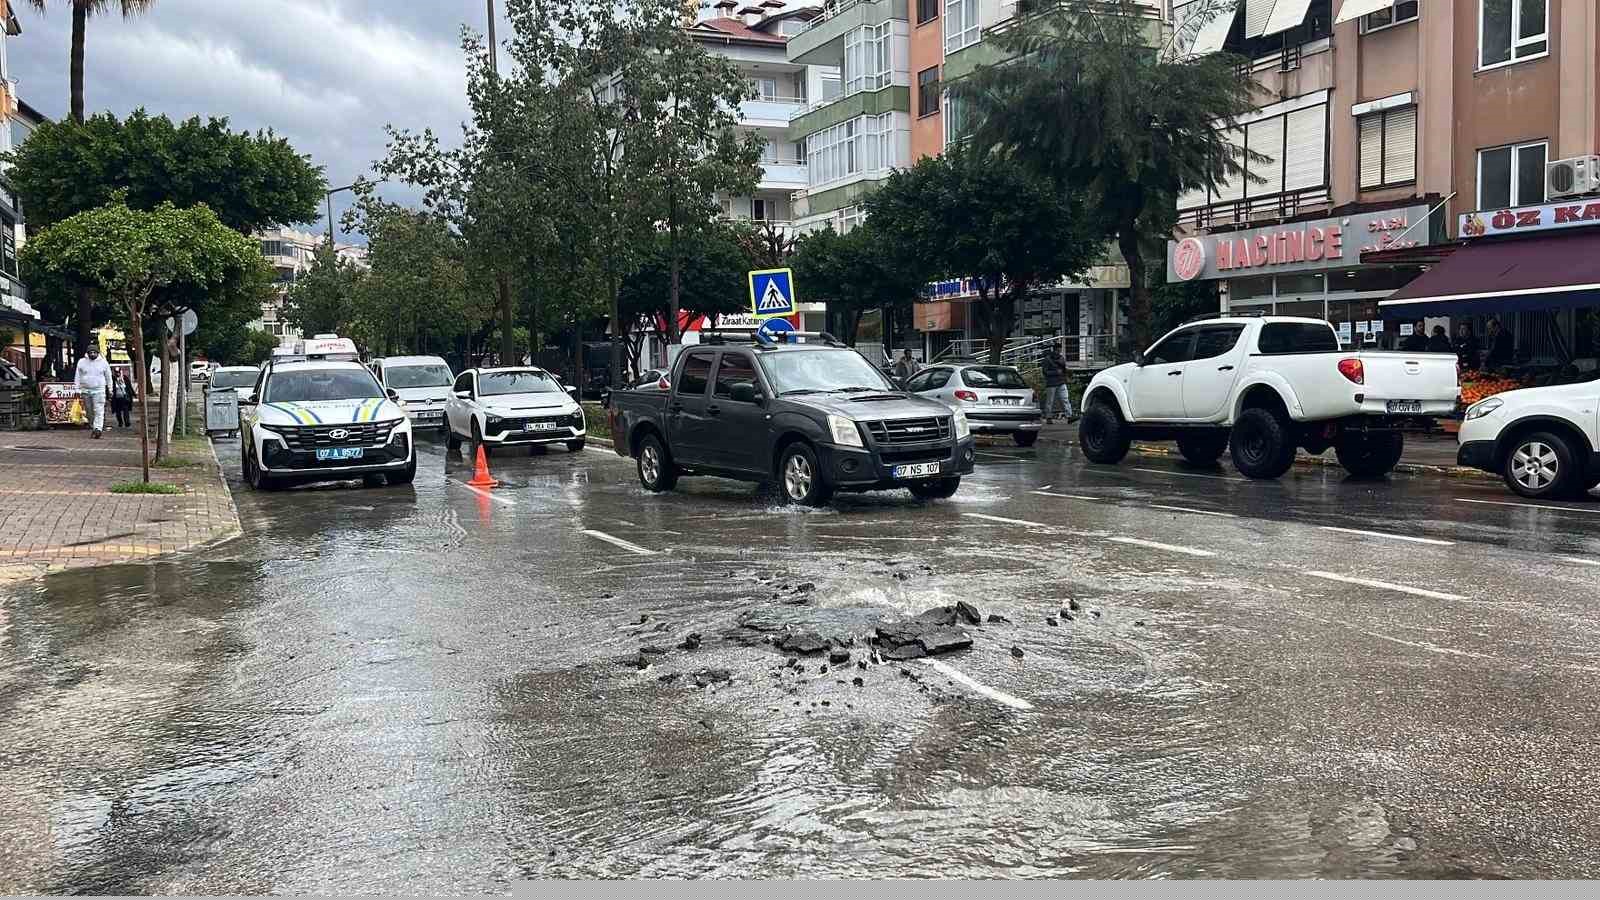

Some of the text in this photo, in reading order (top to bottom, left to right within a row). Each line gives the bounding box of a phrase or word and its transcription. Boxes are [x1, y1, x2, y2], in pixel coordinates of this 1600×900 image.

[1492, 209, 1541, 230] ÖZ
[722, 316, 742, 326] Ziraat
[320, 449, 330, 457] 07
[333, 448, 339, 457] A
[897, 463, 939, 477] 07 NS 107
